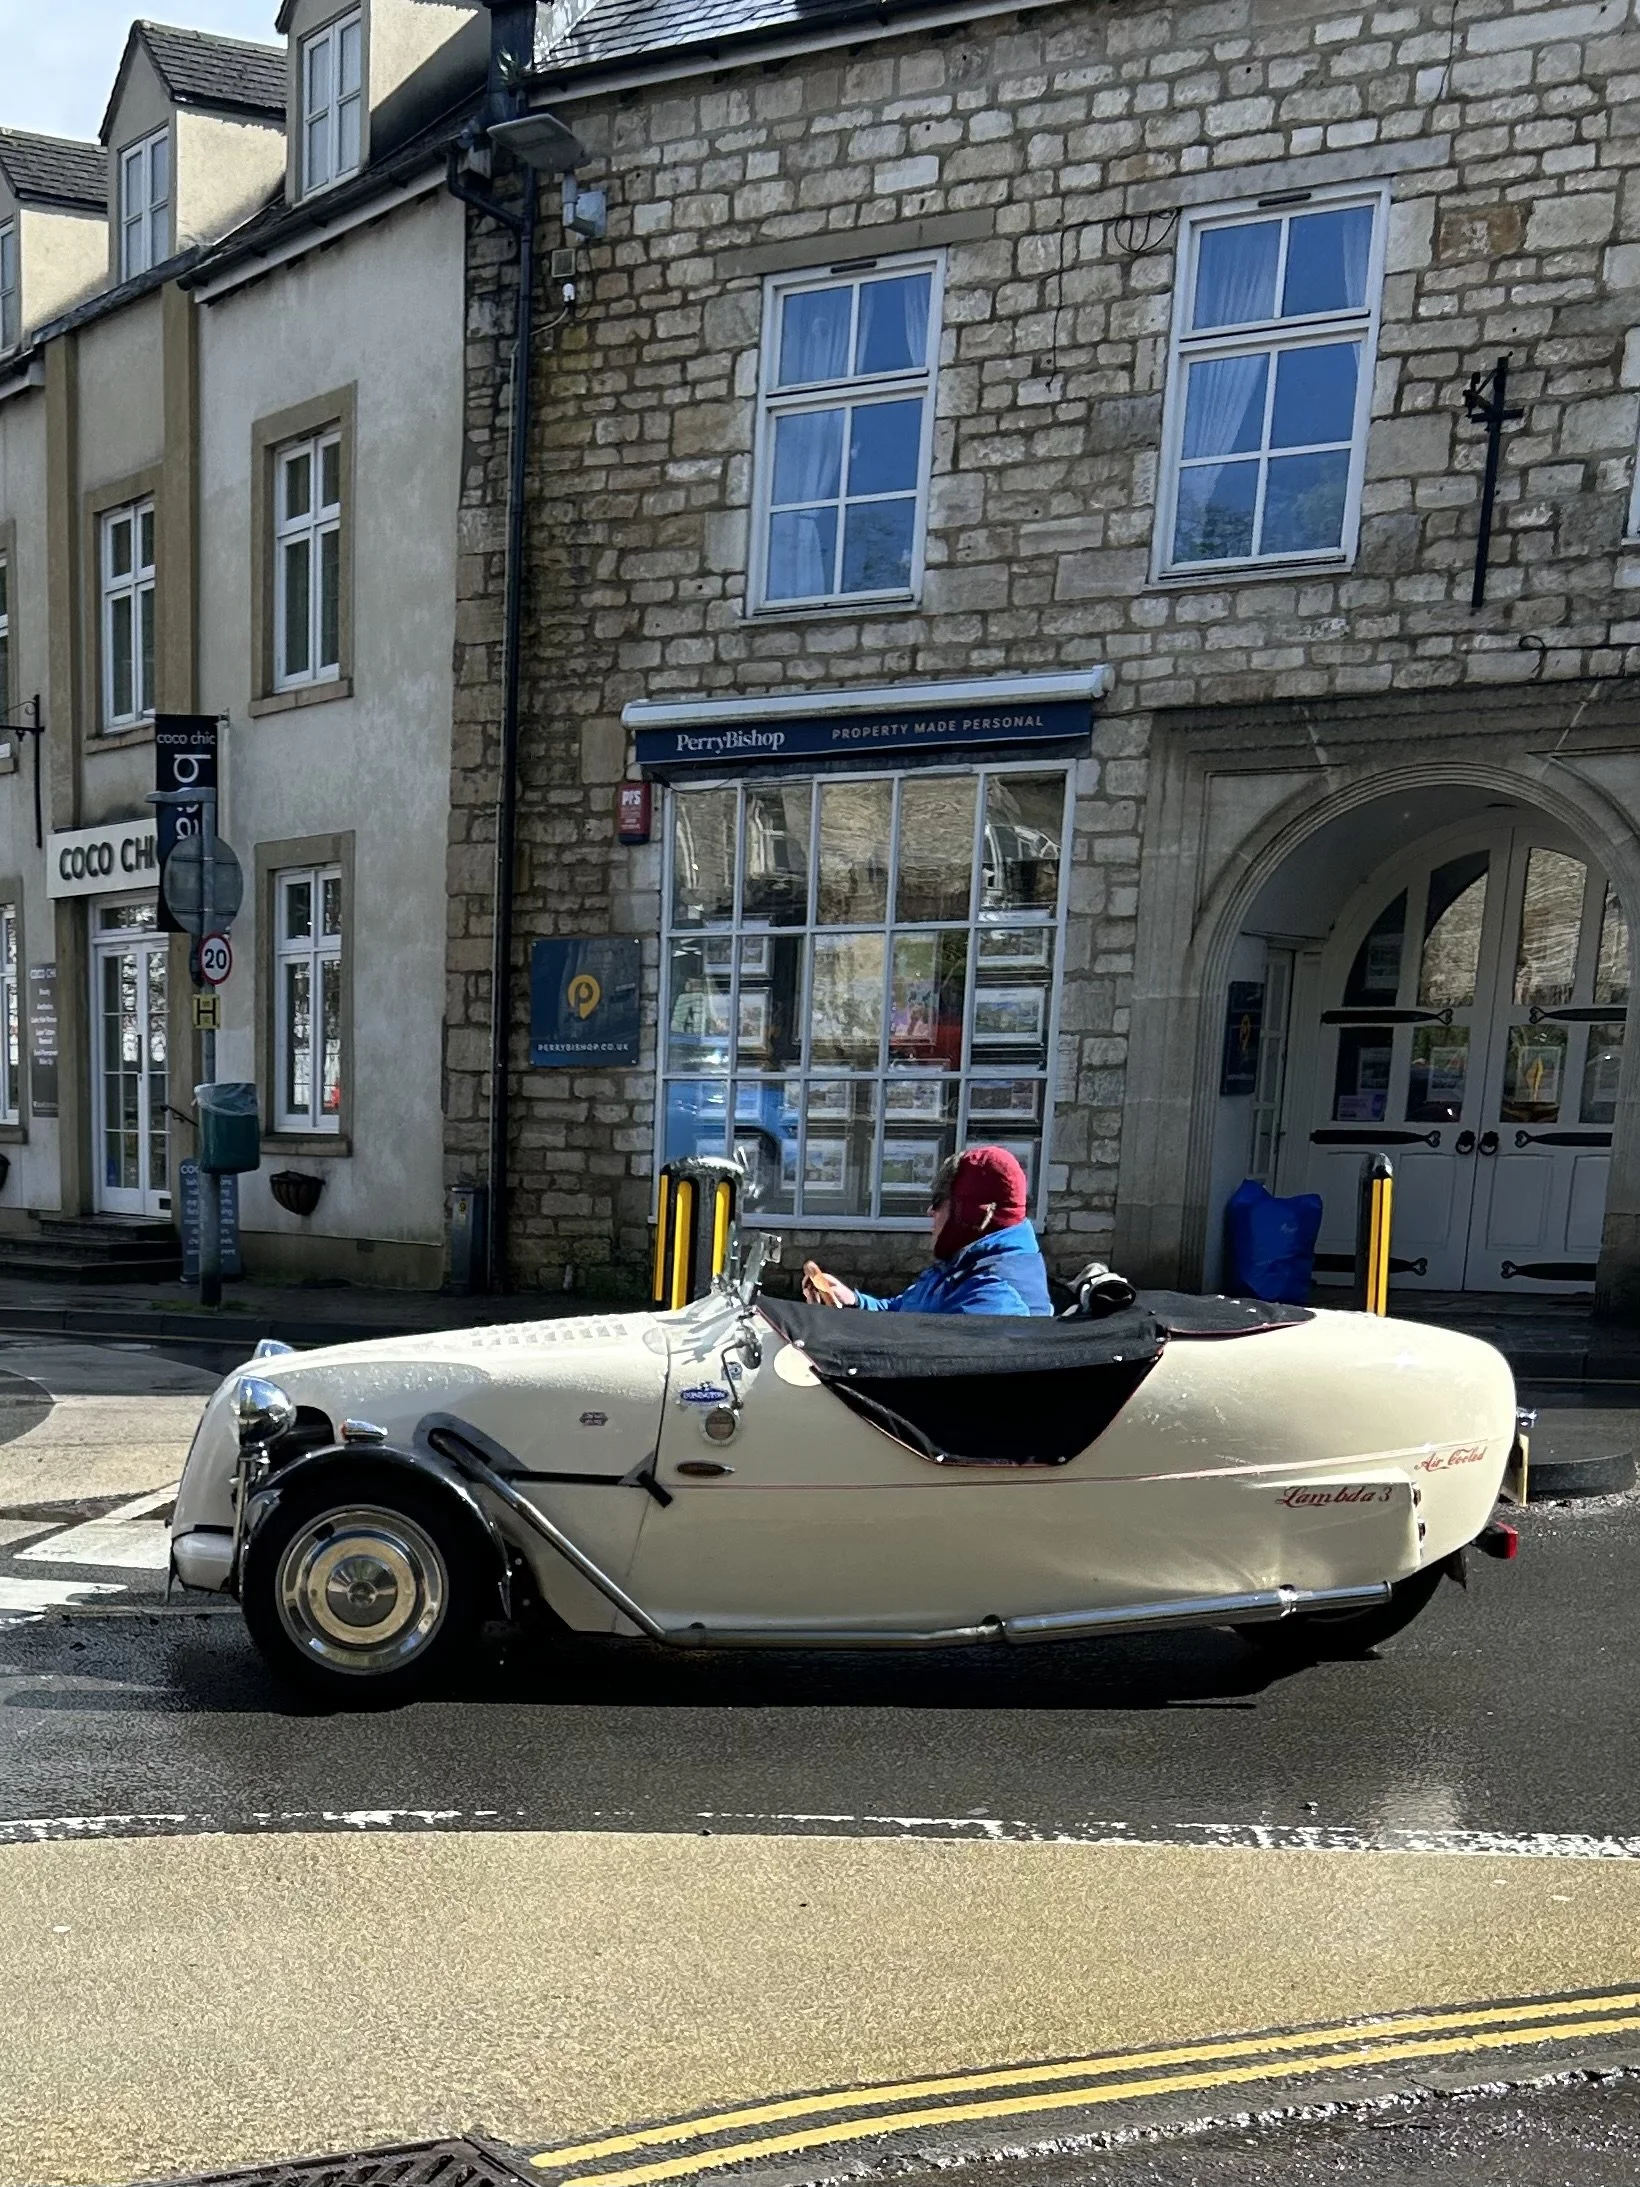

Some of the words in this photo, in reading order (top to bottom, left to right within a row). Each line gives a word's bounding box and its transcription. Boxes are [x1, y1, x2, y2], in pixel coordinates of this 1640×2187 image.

[156, 733, 188, 745] coco
[190, 730, 216, 745] chic
[832, 723, 909, 740] PROPERTY
[914, 719, 959, 734] MADE
[963, 714, 1044, 731] PERSONAL
[676, 728, 786, 754] PerryBishop
[59, 841, 114, 880] COCO
[121, 834, 156, 873] CHI
[204, 948, 227, 969] 20
[197, 998, 216, 1025] H
[1414, 1451, 1448, 1472] Air
[1275, 1485, 1376, 1508] Lambda
[1379, 1486, 1393, 1502] 3
